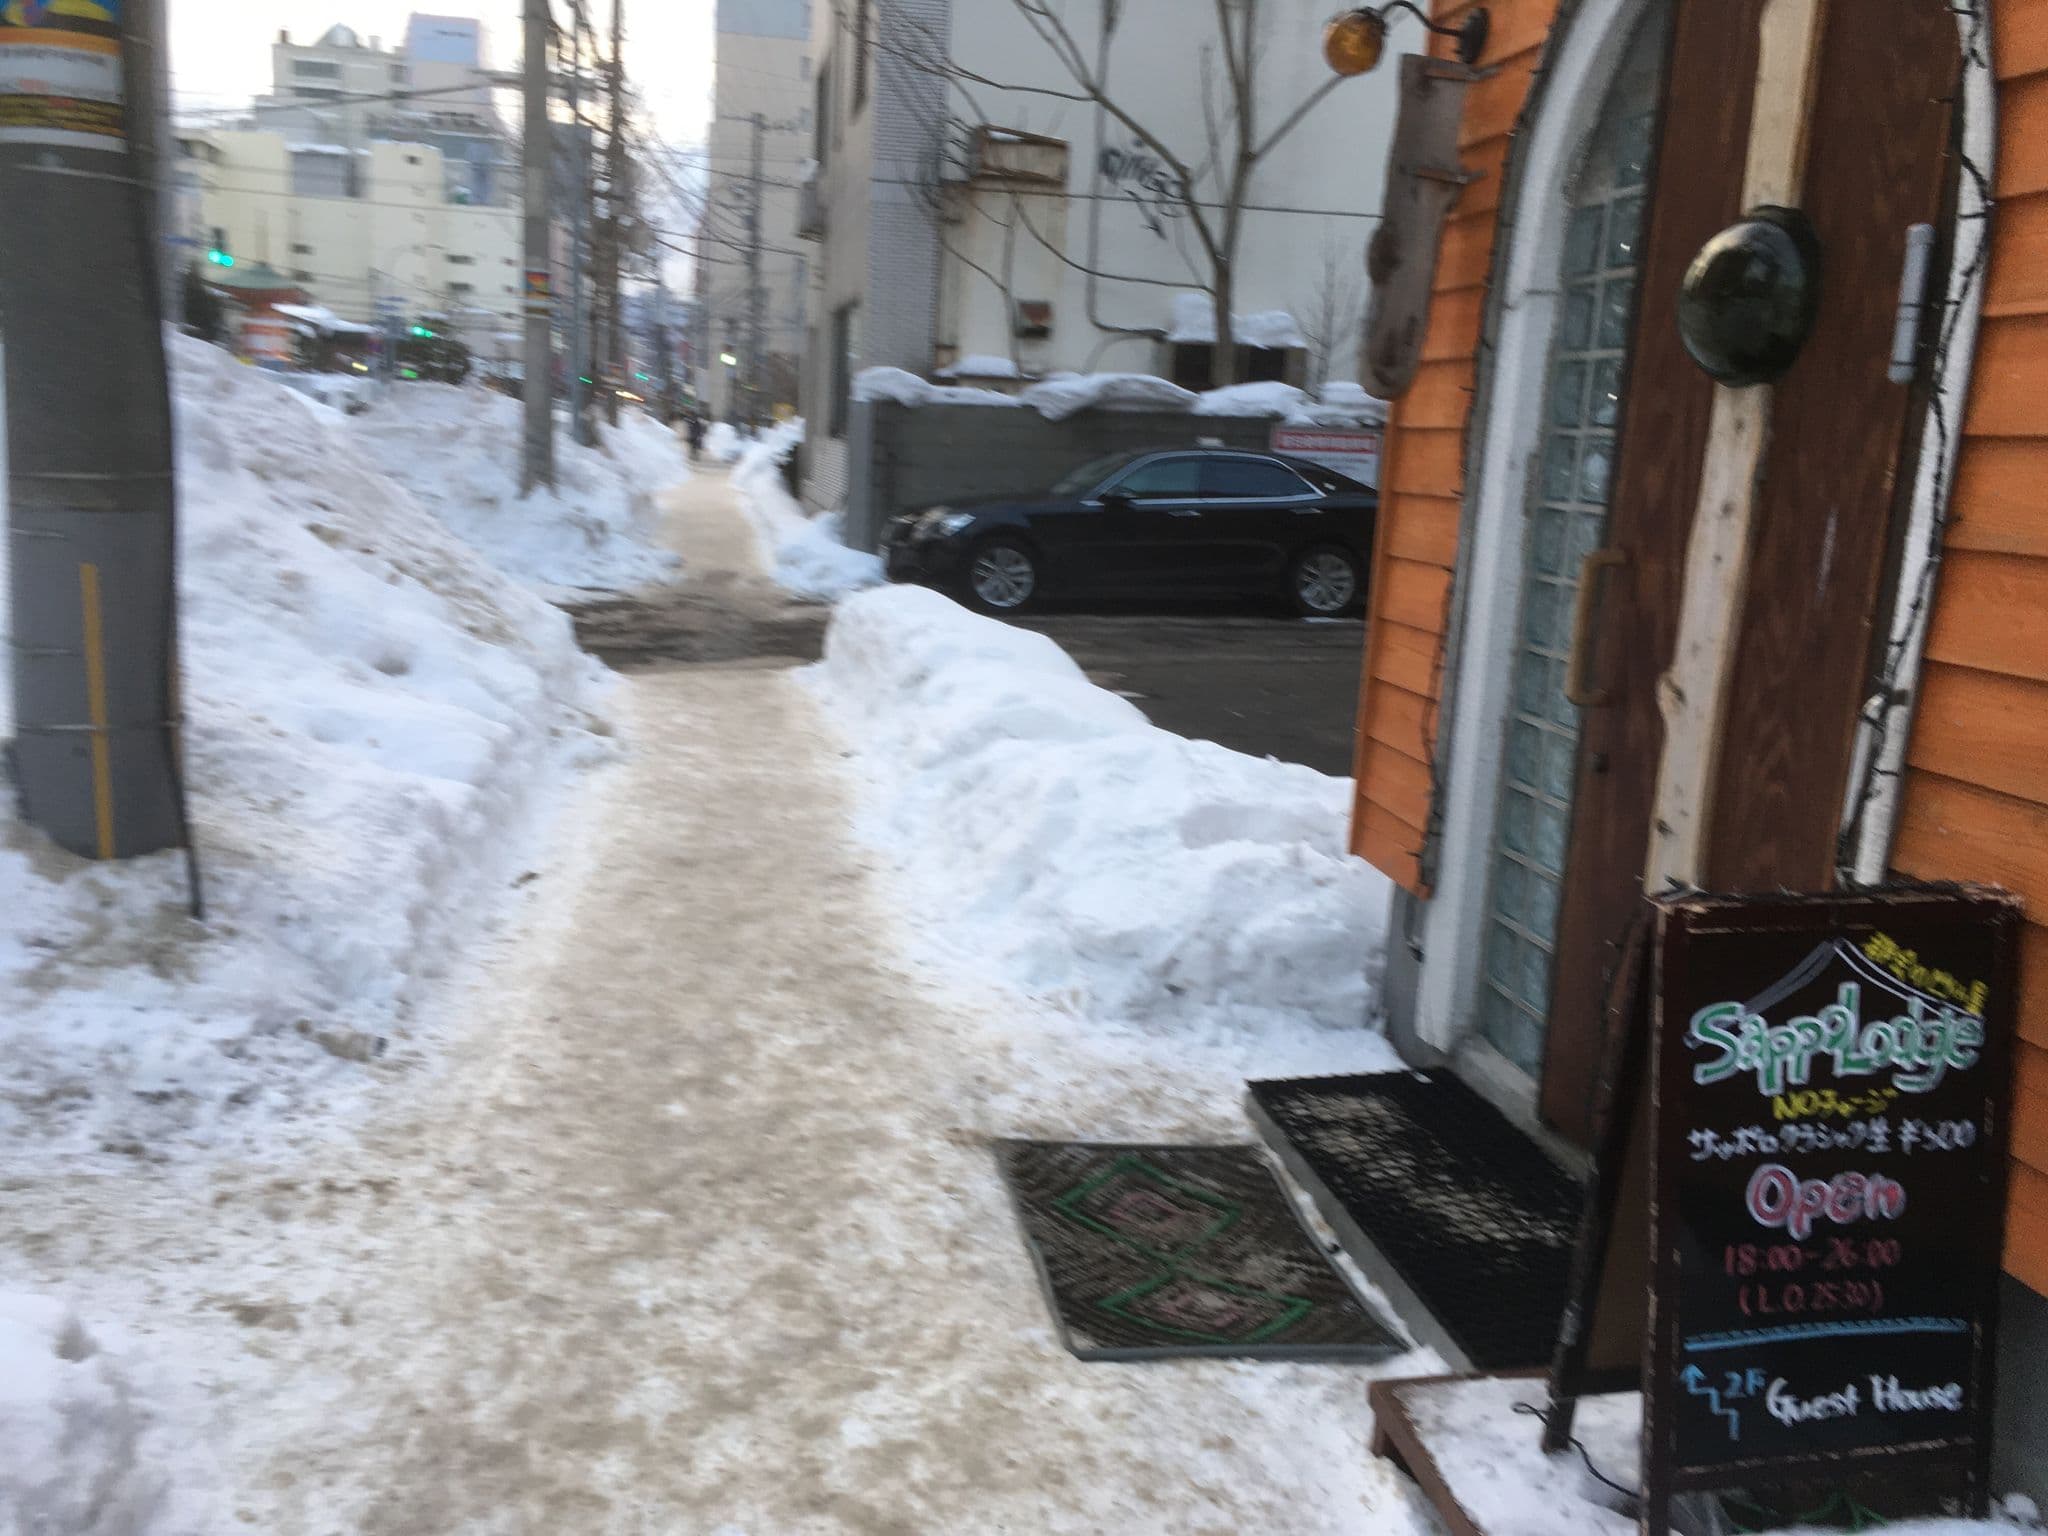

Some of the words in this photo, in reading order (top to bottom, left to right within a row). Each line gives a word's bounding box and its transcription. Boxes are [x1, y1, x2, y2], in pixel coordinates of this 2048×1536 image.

[1746, 1163, 1907, 1241] Open
[1723, 1367, 1768, 1399] 2F
[1766, 1376, 1861, 1427] Guest
[1866, 1373, 1964, 1414] House
